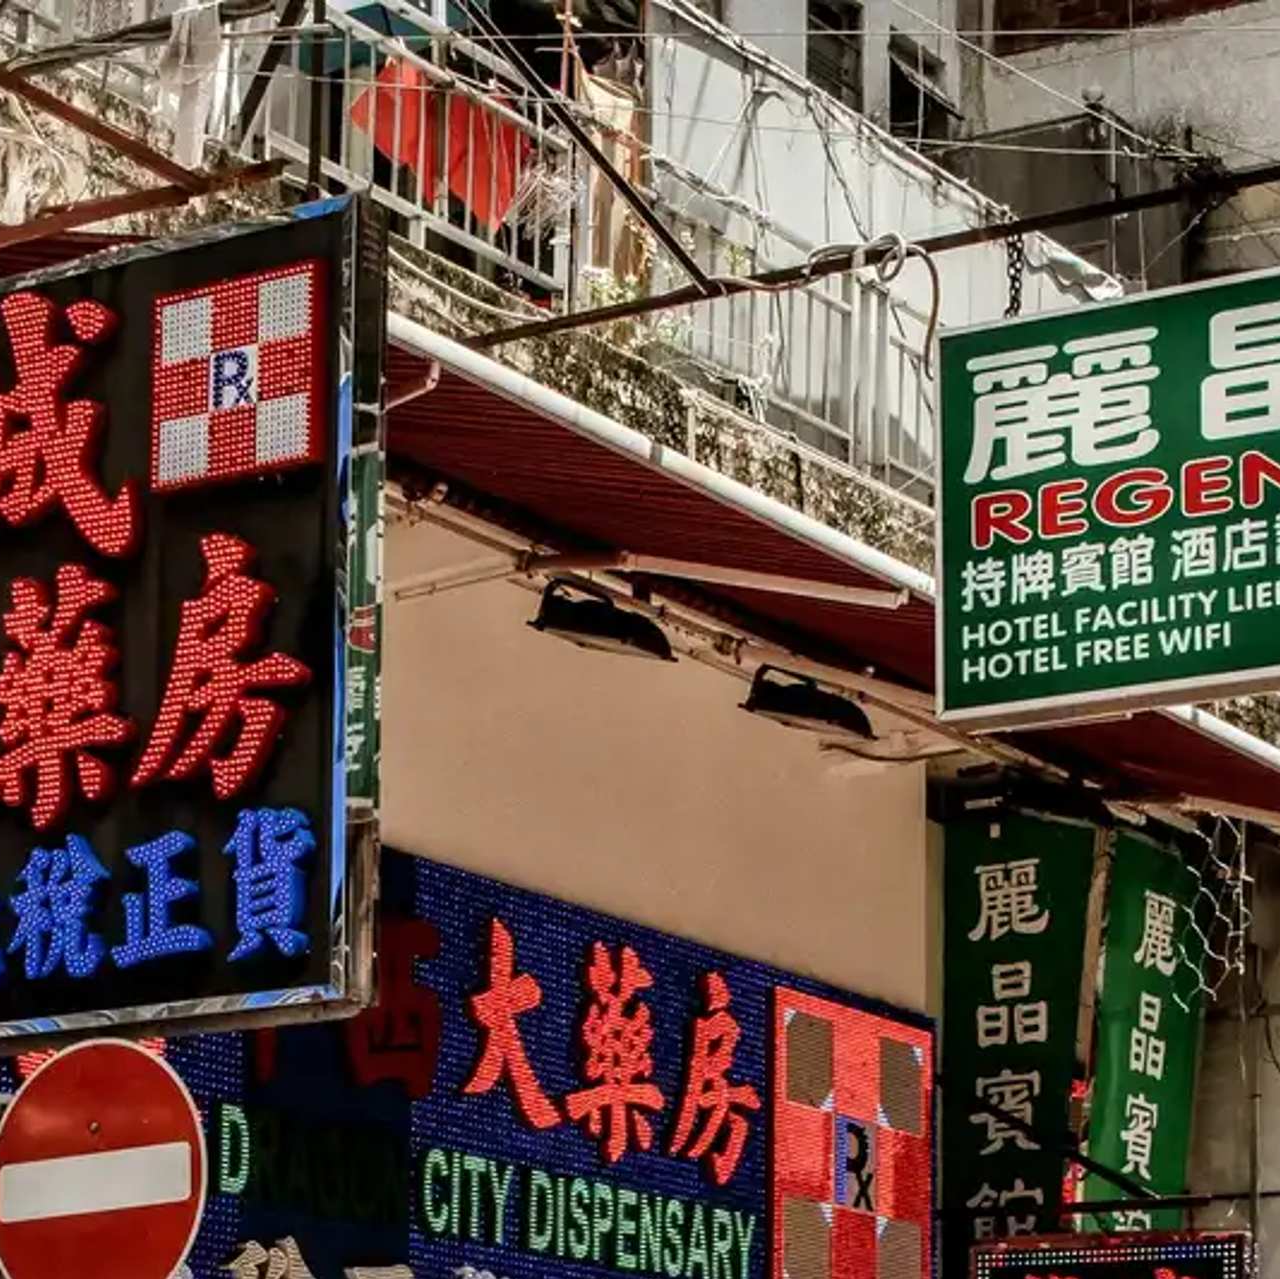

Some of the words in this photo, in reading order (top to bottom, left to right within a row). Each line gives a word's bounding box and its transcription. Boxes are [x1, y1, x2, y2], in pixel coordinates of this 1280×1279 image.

[960, 533, 1156, 612] 持牌賓館
[961, 608, 1069, 651] HOTEL
[1075, 590, 1215, 639] FACILITY
[961, 642, 1069, 684] HOTEL
[1075, 633, 1152, 671] FREE
[1158, 622, 1232, 662] WIFI
[423, 1148, 516, 1248] CITY
